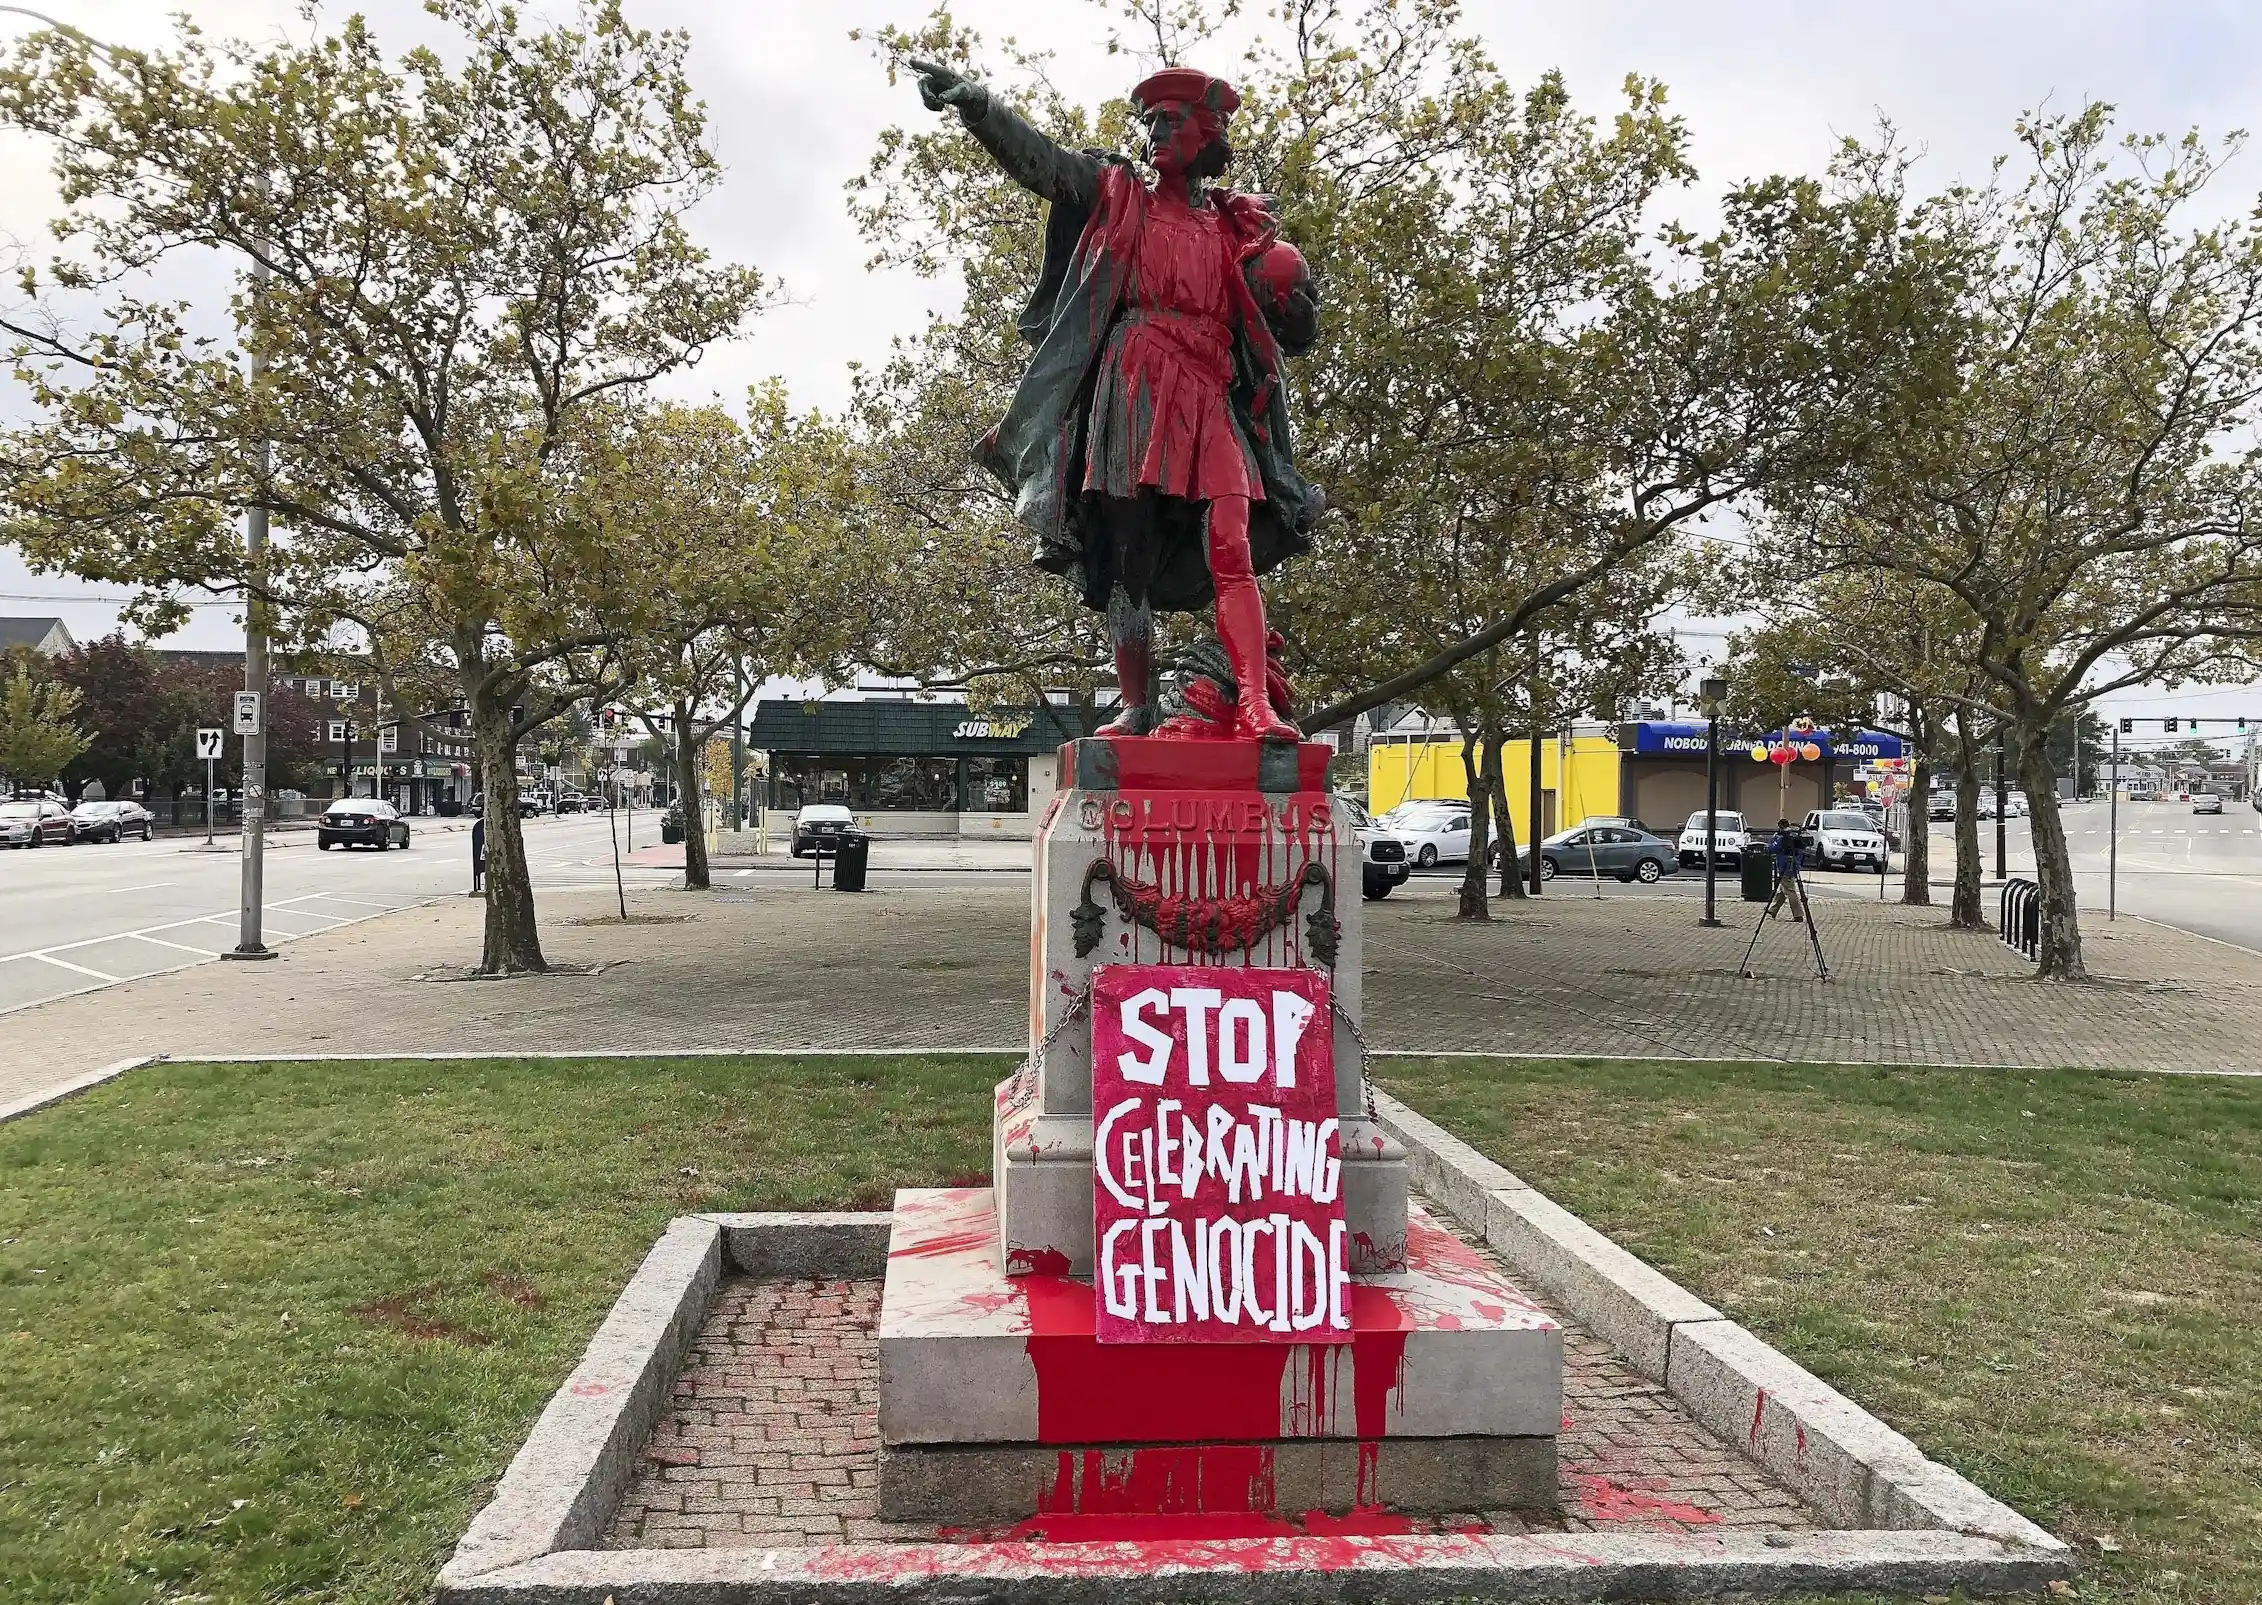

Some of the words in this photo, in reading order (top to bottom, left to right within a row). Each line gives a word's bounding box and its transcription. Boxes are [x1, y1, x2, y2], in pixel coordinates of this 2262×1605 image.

[953, 721, 1026, 738] SUBWAY
[1664, 737, 1711, 750] NOBOD
[1881, 784, 1895, 798] STOP
[1077, 798, 1333, 834] COLUMBUS
[1116, 987, 1316, 1089] STOP
[1095, 1098, 1342, 1215] CELEBRATING
[1100, 1212, 1352, 1332] GENOCIDE
